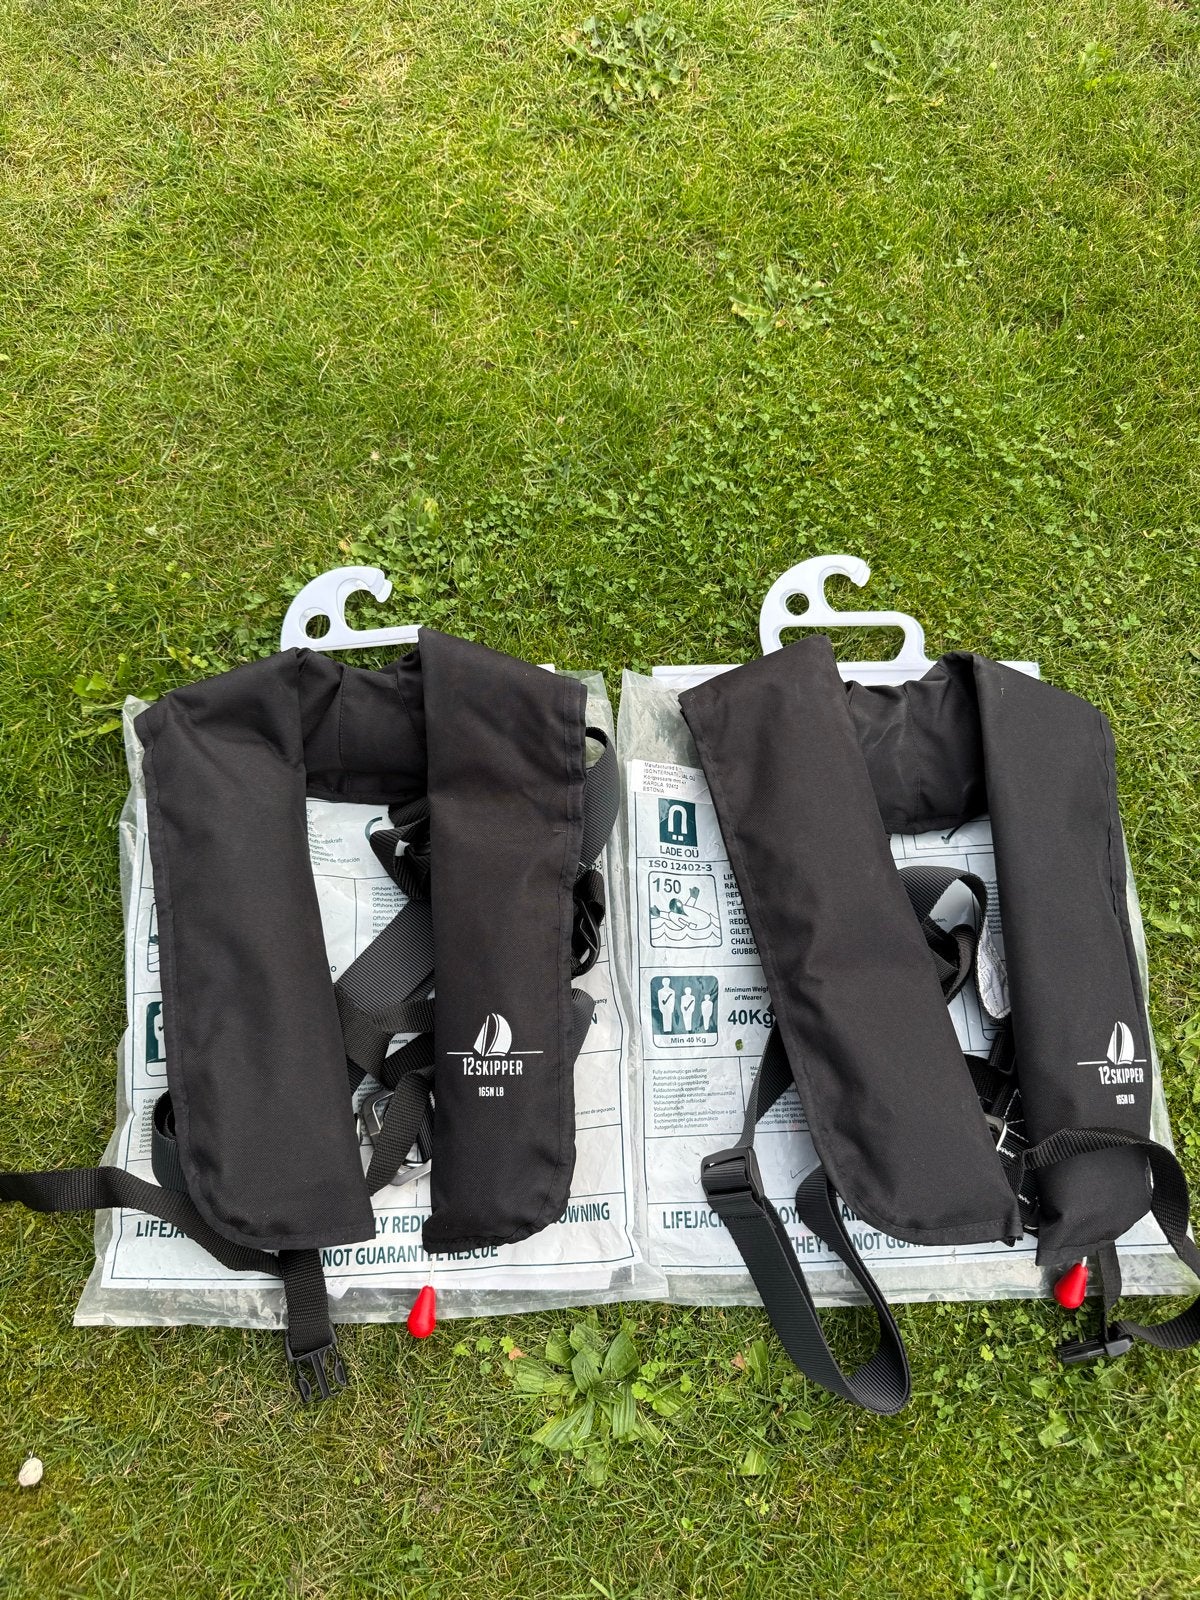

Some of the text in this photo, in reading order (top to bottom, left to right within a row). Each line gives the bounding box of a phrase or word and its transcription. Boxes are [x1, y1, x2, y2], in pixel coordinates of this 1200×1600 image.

[660, 845, 699, 858] LADE OÜ
[649, 860, 712, 872] ISO 12402-3
[652, 877, 682, 894] 150
[728, 1010, 774, 1028] 40Kg
[462, 1057, 523, 1076] 12SKIPPER
[1098, 1066, 1144, 1084] 12SKIPPER
[478, 1086, 494, 1096] 165N
[136, 1220, 185, 1238] LIFEJA
[852, 1232, 882, 1250] NOT
[322, 1248, 352, 1268] NOT
